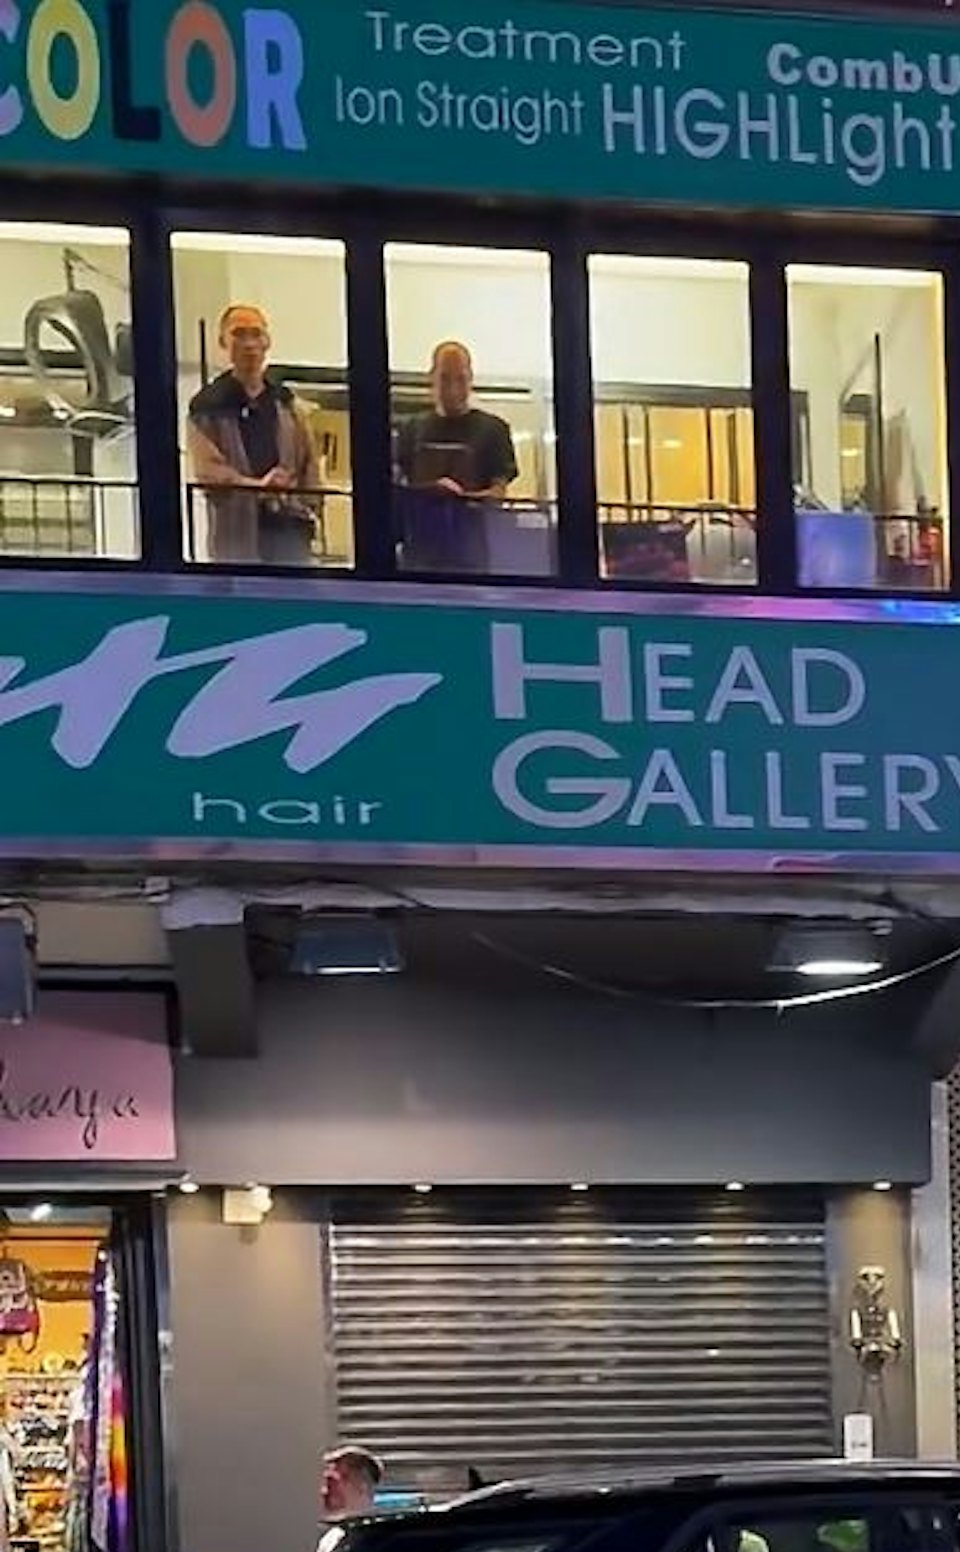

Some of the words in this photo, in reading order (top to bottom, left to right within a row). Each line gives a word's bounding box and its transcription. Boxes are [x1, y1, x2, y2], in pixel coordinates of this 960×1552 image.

[365, 10, 687, 71] Treatment
[414, 83, 585, 146] Straight
[601, 82, 957, 185] HIGHLight
[491, 623, 866, 728] HEAD
[190, 790, 383, 825] hair
